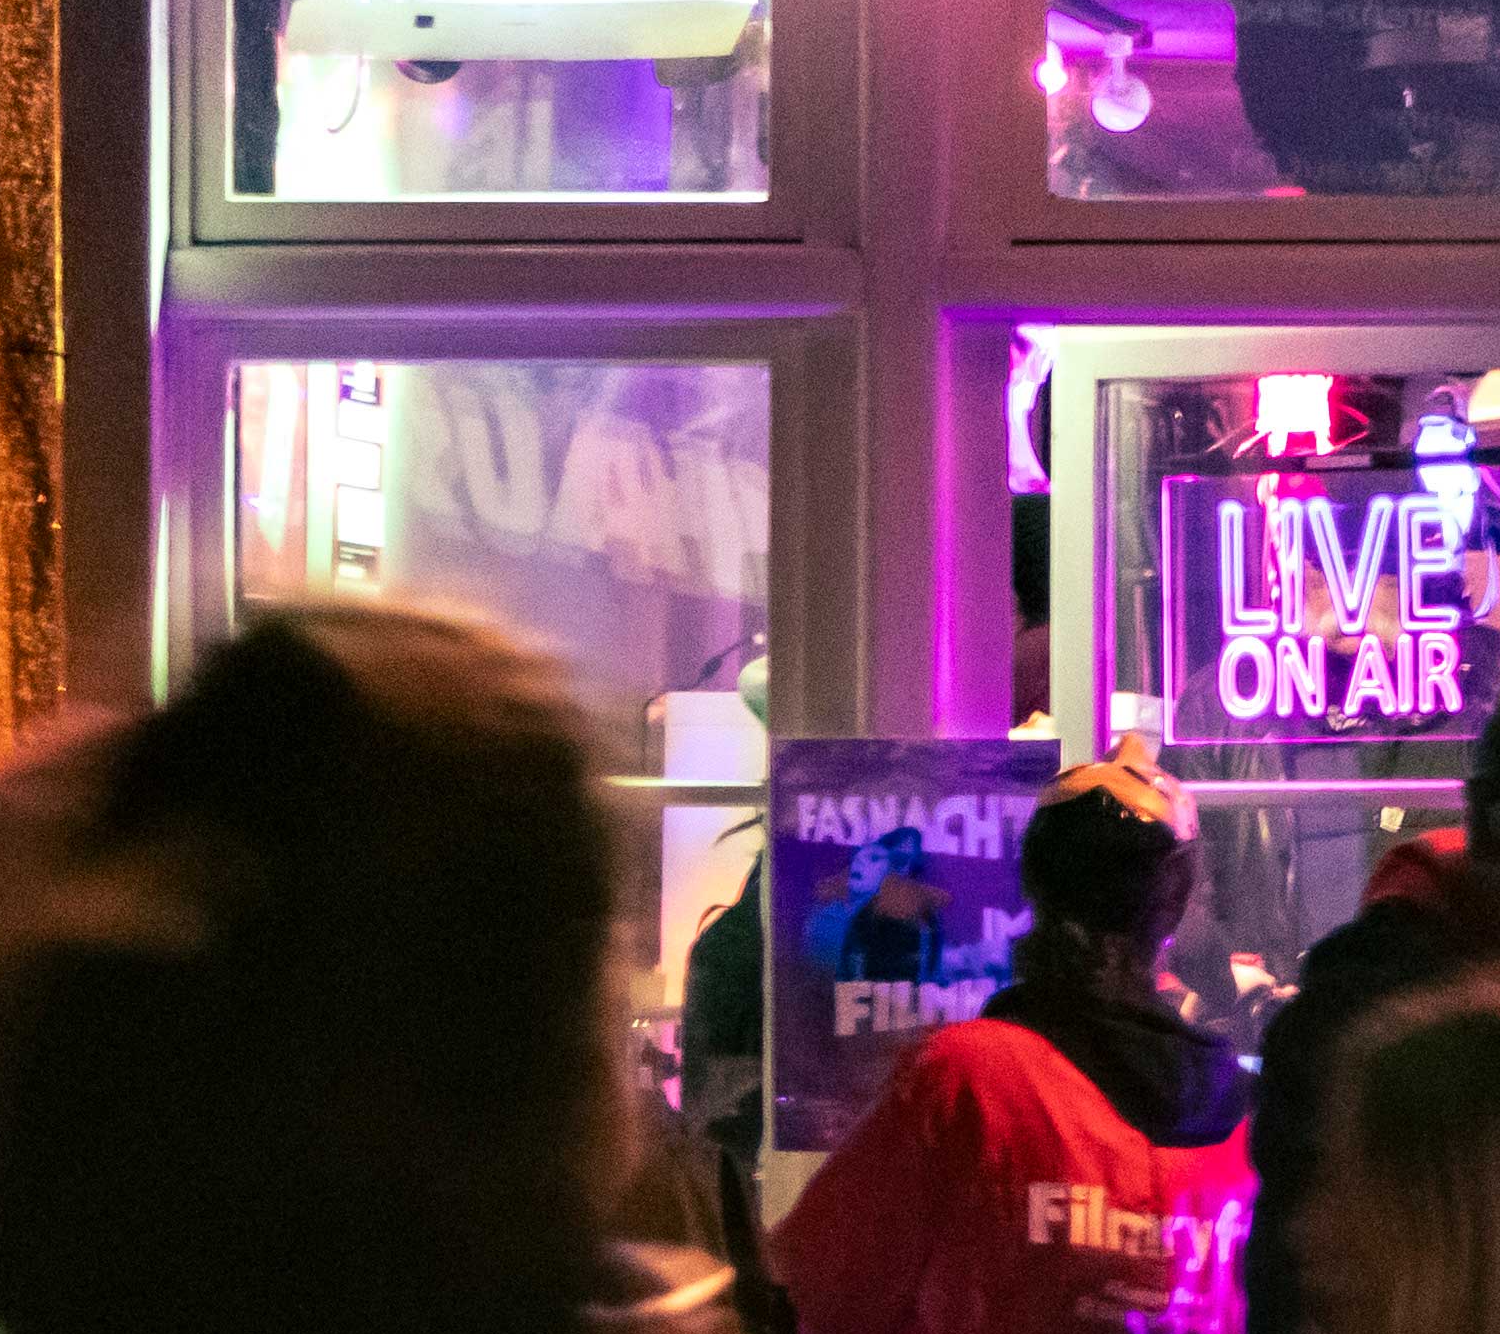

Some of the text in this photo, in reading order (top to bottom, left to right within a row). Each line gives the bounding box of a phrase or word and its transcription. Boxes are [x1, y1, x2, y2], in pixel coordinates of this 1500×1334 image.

[1218, 495, 1460, 635] LIVE
[1218, 633, 1464, 719] ON AIR
[797, 794, 1038, 860] FASNACHT
